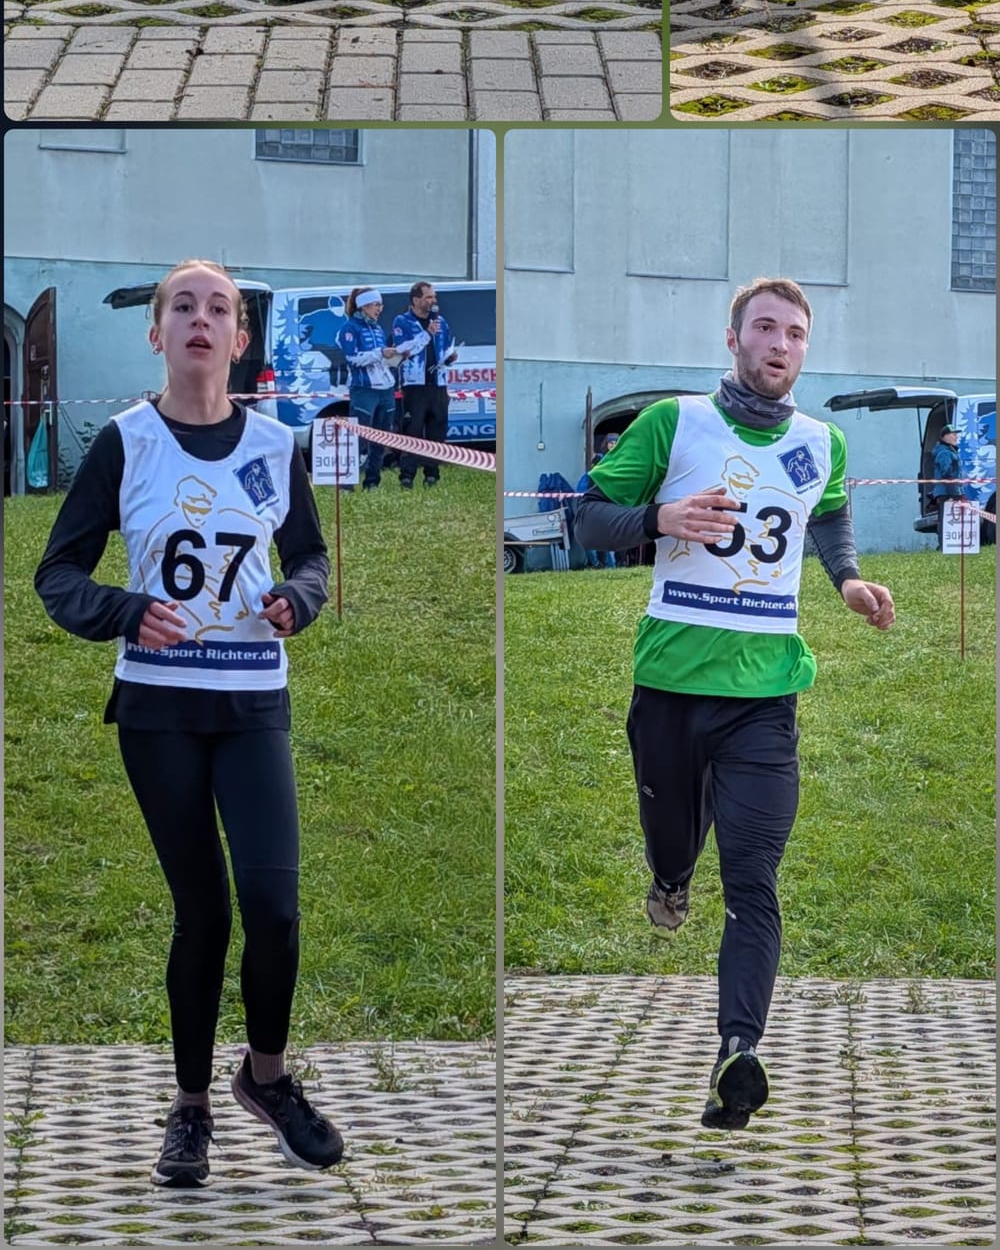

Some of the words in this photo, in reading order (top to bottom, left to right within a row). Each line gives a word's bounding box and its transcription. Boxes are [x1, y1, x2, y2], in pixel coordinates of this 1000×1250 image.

[704, 502, 792, 563] 53
[161, 529, 257, 602] 67
[667, 588, 740, 604] www.Sport
[206, 648, 278, 661] Richter.de
